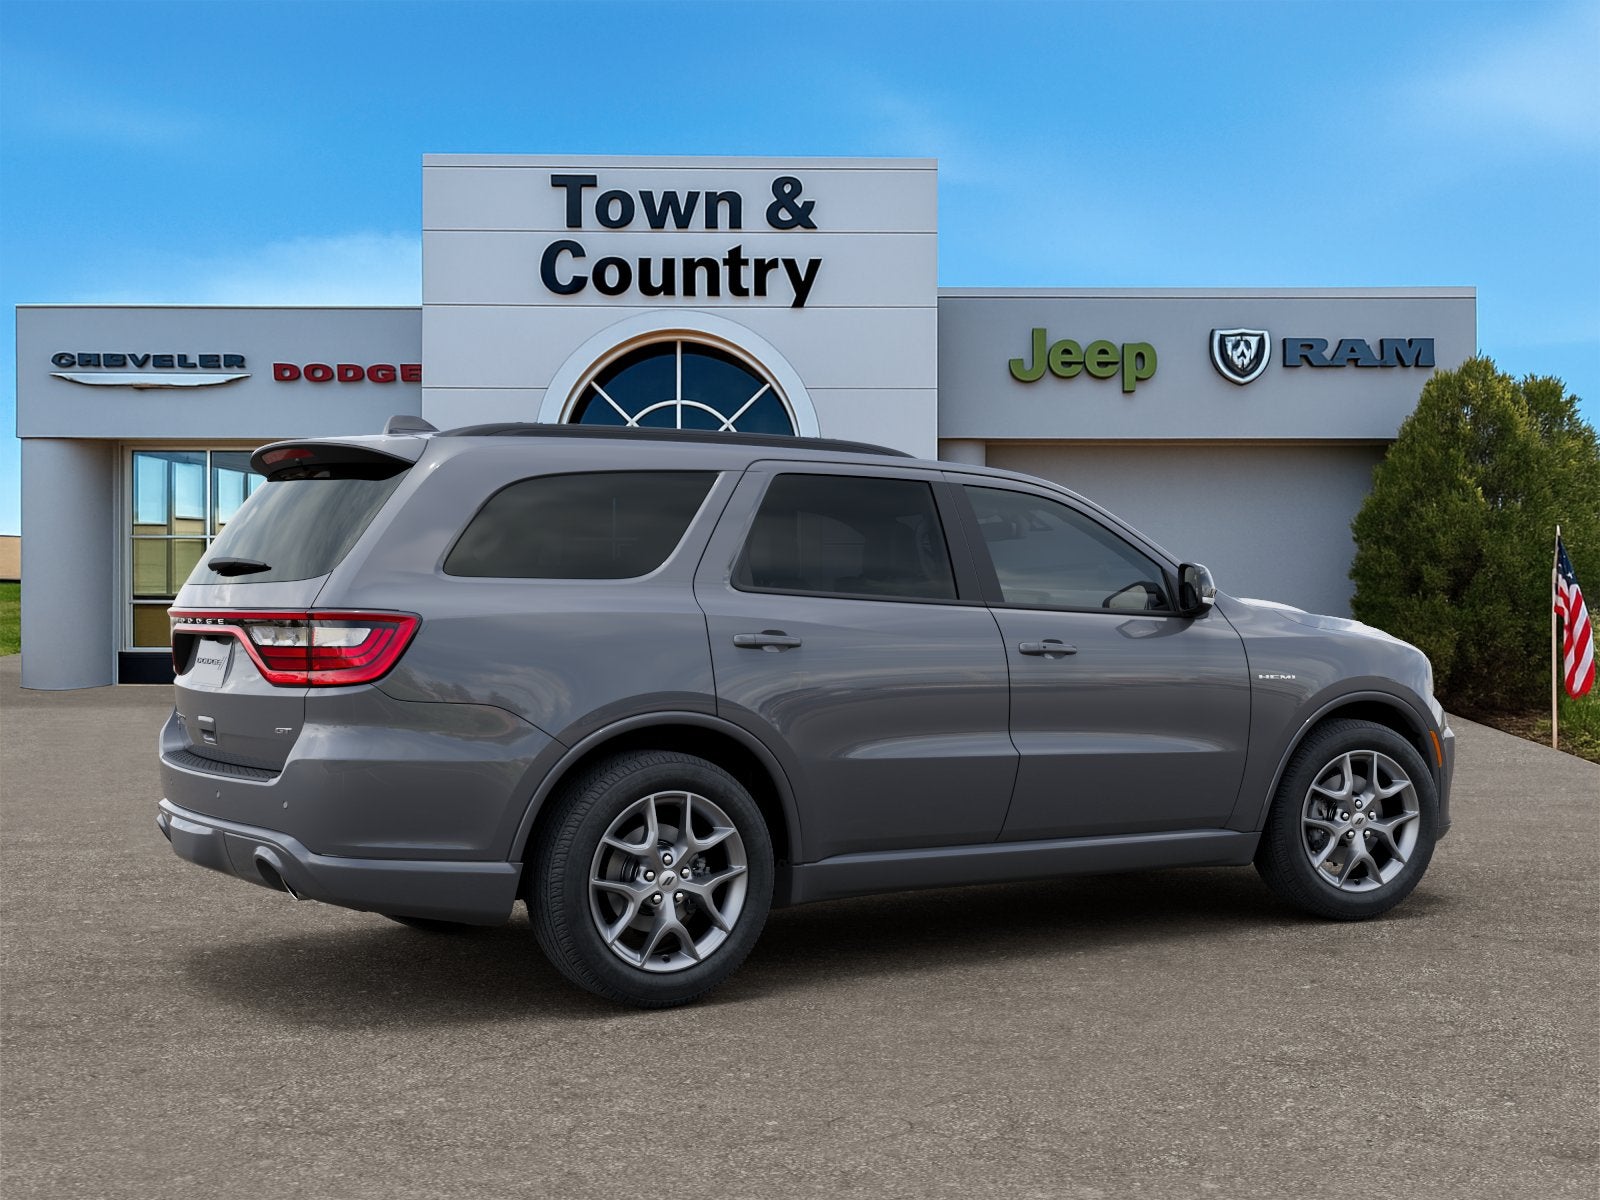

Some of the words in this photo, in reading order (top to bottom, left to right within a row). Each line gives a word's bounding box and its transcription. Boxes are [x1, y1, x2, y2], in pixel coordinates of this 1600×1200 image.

[550, 174, 742, 229] Town
[765, 175, 818, 230] &
[540, 239, 822, 308] Country
[273, 362, 422, 384] DODGE
[1009, 328, 1157, 393] Jeep
[1283, 337, 1436, 367] RAM
[275, 727, 293, 735] GT
